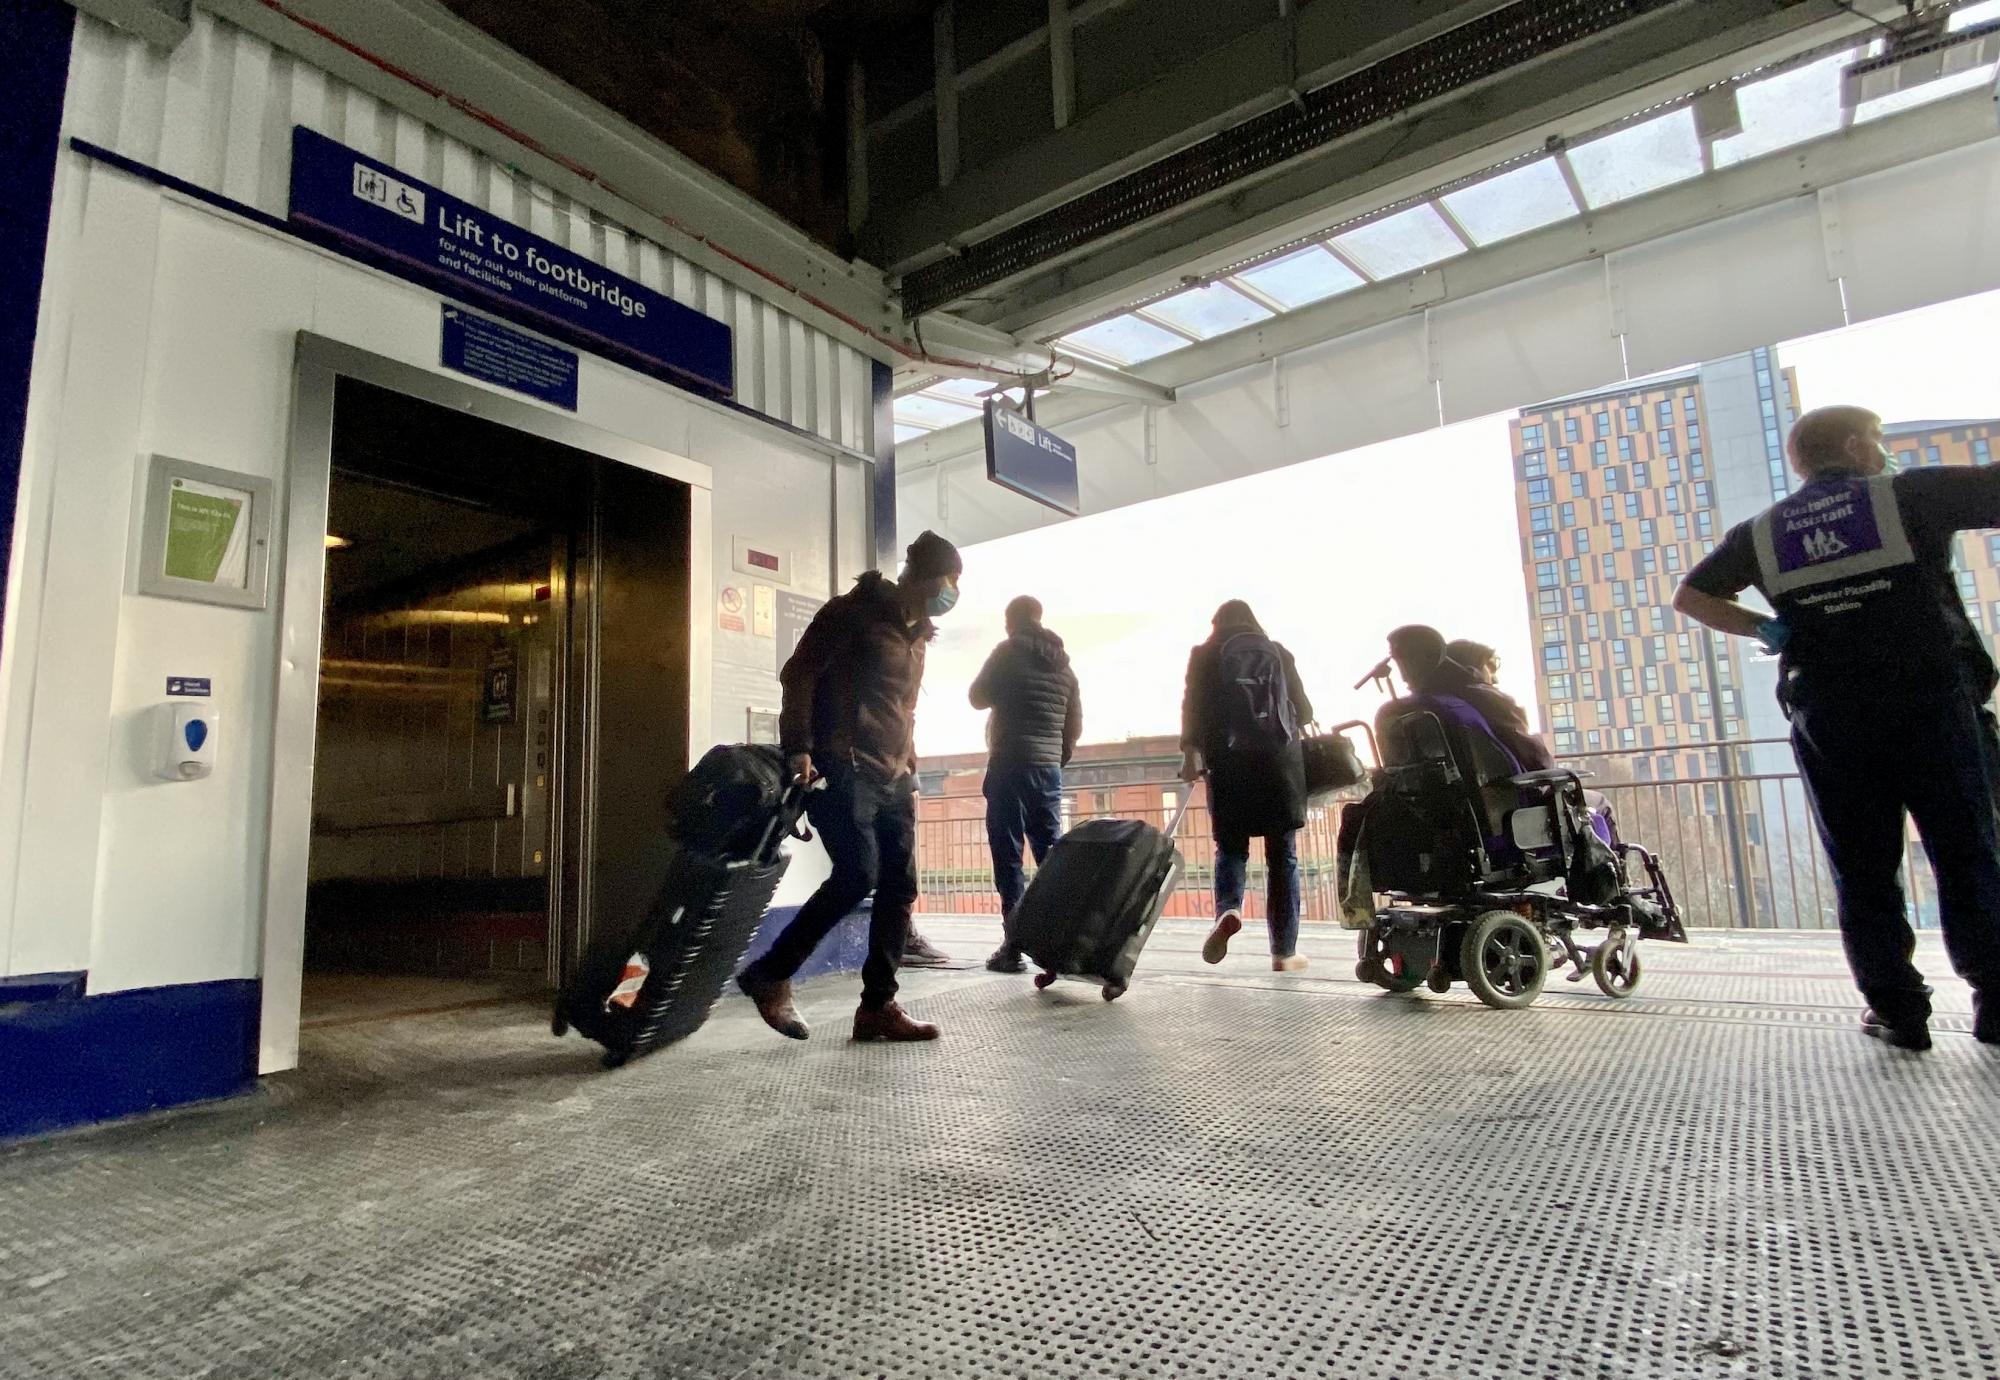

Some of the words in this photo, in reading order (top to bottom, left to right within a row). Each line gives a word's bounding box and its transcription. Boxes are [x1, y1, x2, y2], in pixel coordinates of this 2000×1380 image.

[438, 206, 484, 247] Lift
[492, 233, 519, 261] to
[526, 247, 646, 318] footbridge
[438, 254, 461, 270] and
[464, 262, 513, 292] facilities
[438, 237, 456, 252] for
[460, 249, 482, 265] way
[485, 258, 504, 274] out
[507, 268, 536, 288] other
[538, 281, 588, 310] platforms
[1038, 433, 1052, 453] Lift
[1782, 490, 1852, 518] Customer
[1785, 503, 1854, 532] Assistant
[1794, 590, 1842, 605] chester
[1844, 579, 1892, 597] Piccadilly
[1823, 601, 1862, 614] Station
